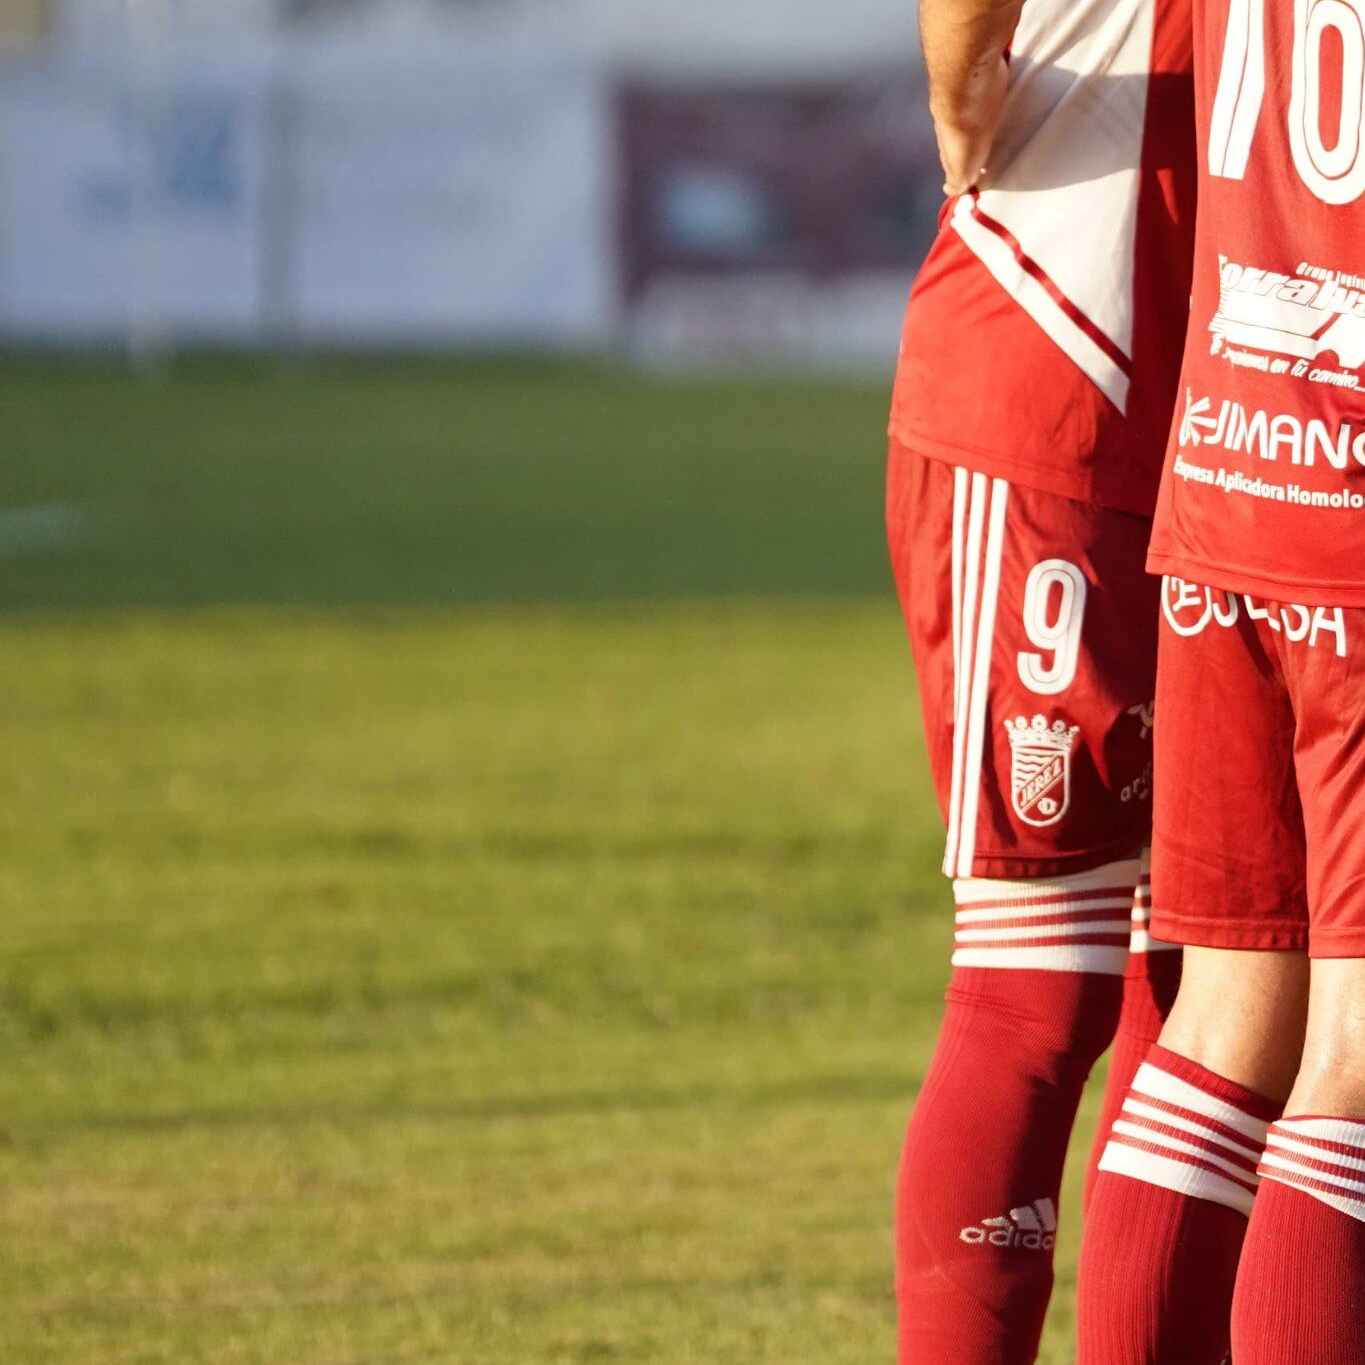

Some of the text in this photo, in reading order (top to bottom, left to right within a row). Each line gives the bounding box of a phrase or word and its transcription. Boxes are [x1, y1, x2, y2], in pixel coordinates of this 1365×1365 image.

[1270, 358, 1290, 374] en
[1215, 468, 1285, 501] Aplicadora
[1017, 559, 1087, 695] 9
[1020, 757, 1062, 808] JEREZ
